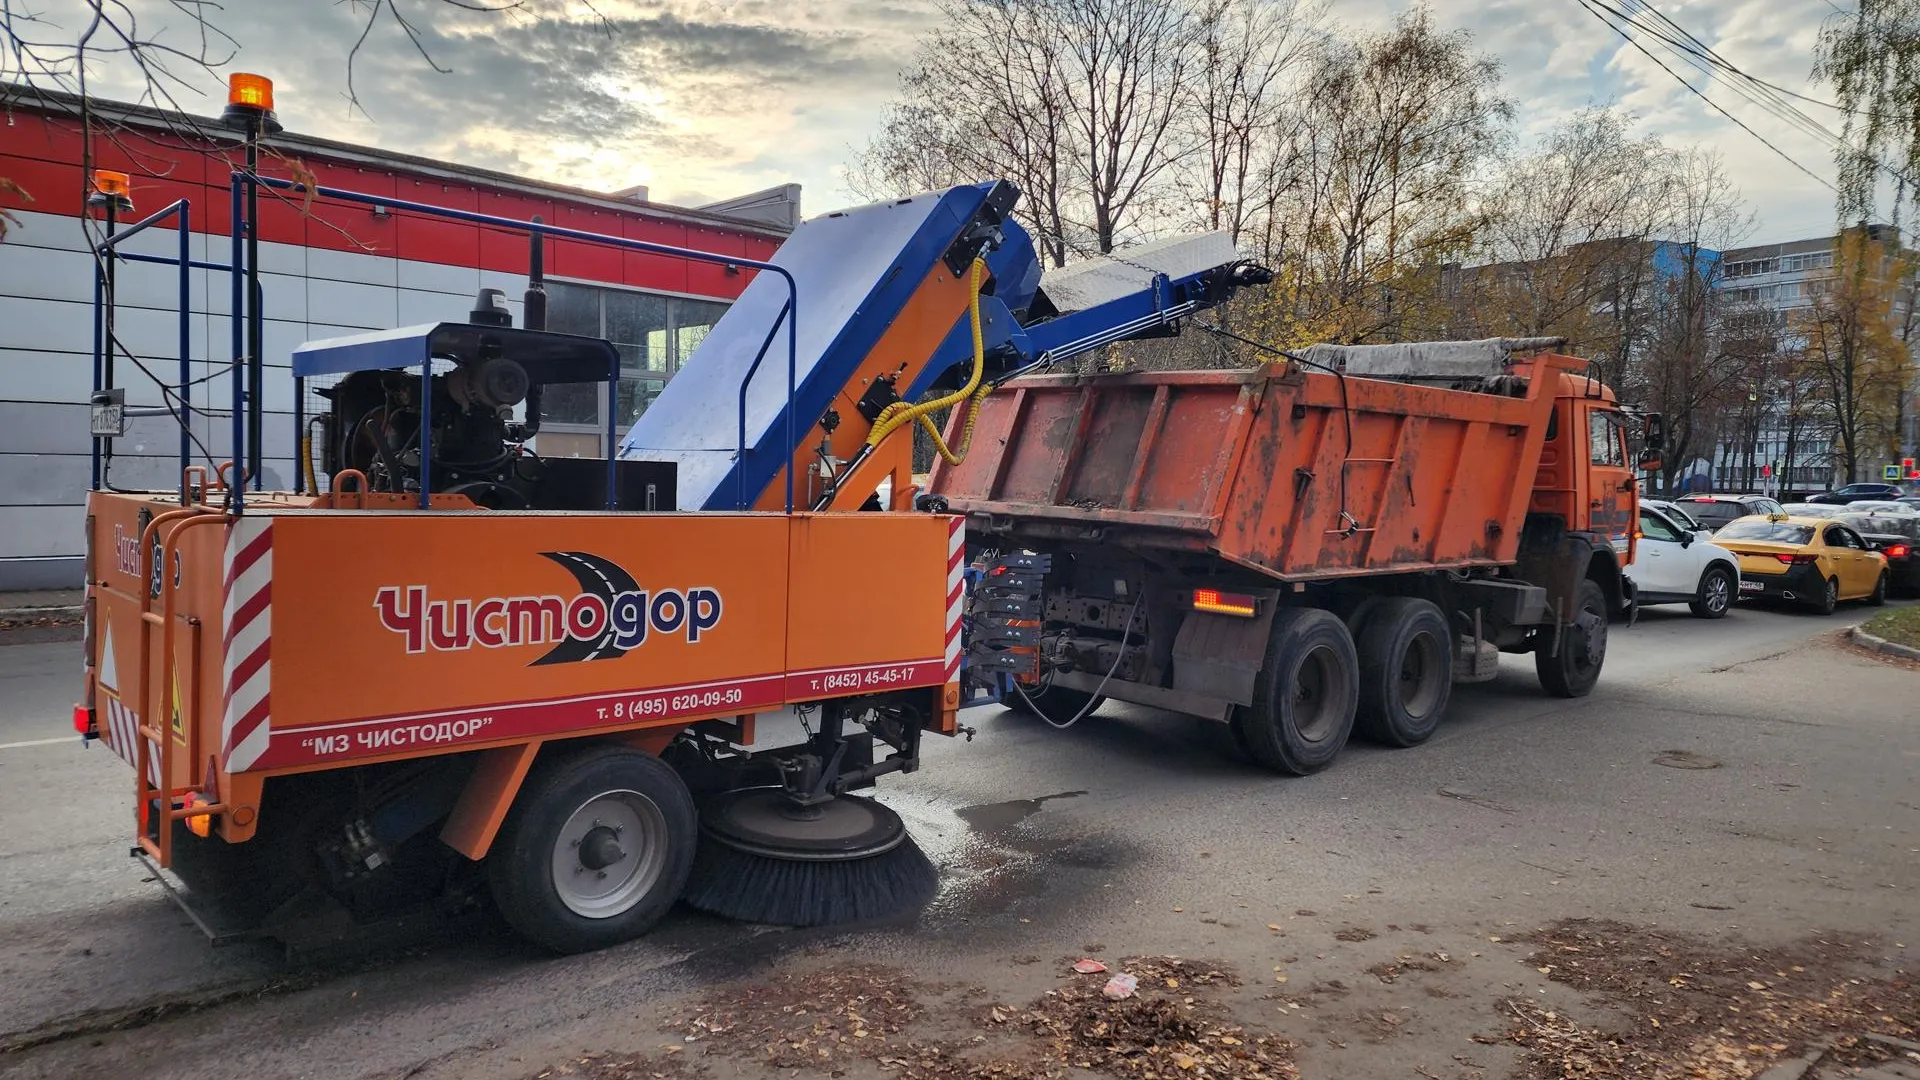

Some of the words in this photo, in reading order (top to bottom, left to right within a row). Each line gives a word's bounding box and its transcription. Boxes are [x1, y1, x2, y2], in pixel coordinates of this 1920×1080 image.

[373, 585, 722, 654] Чистодор
[824, 672, 862, 692] (8452)
[865, 667, 915, 685] 45-45-17
[614, 702, 624, 718] 8
[628, 697, 668, 720] (495)
[672, 688, 742, 711] 620-09-50
